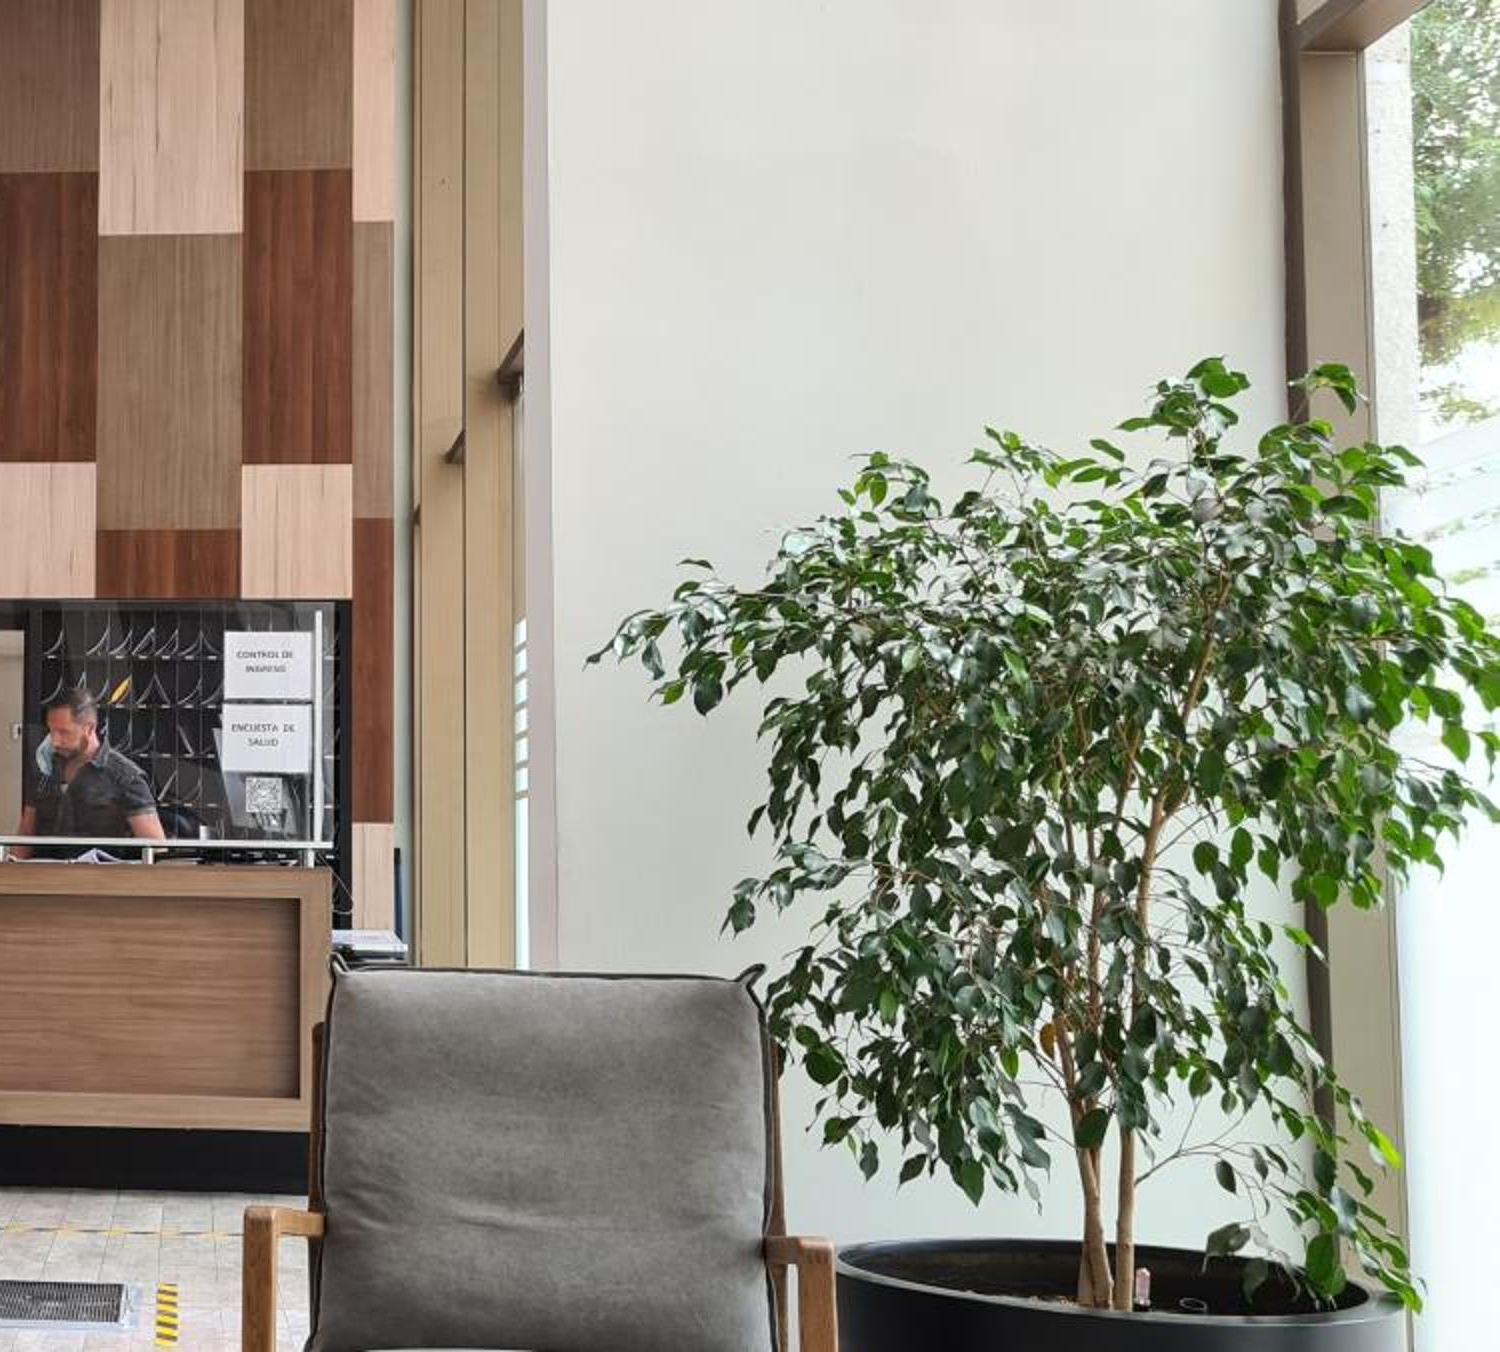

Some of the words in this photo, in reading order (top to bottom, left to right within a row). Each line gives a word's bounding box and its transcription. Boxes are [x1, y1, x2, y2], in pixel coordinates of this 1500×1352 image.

[236, 651, 279, 659] CONTROL
[231, 723, 279, 733] ENCUESTA
[283, 723, 296, 733] DE
[248, 737, 279, 747] SALUD
